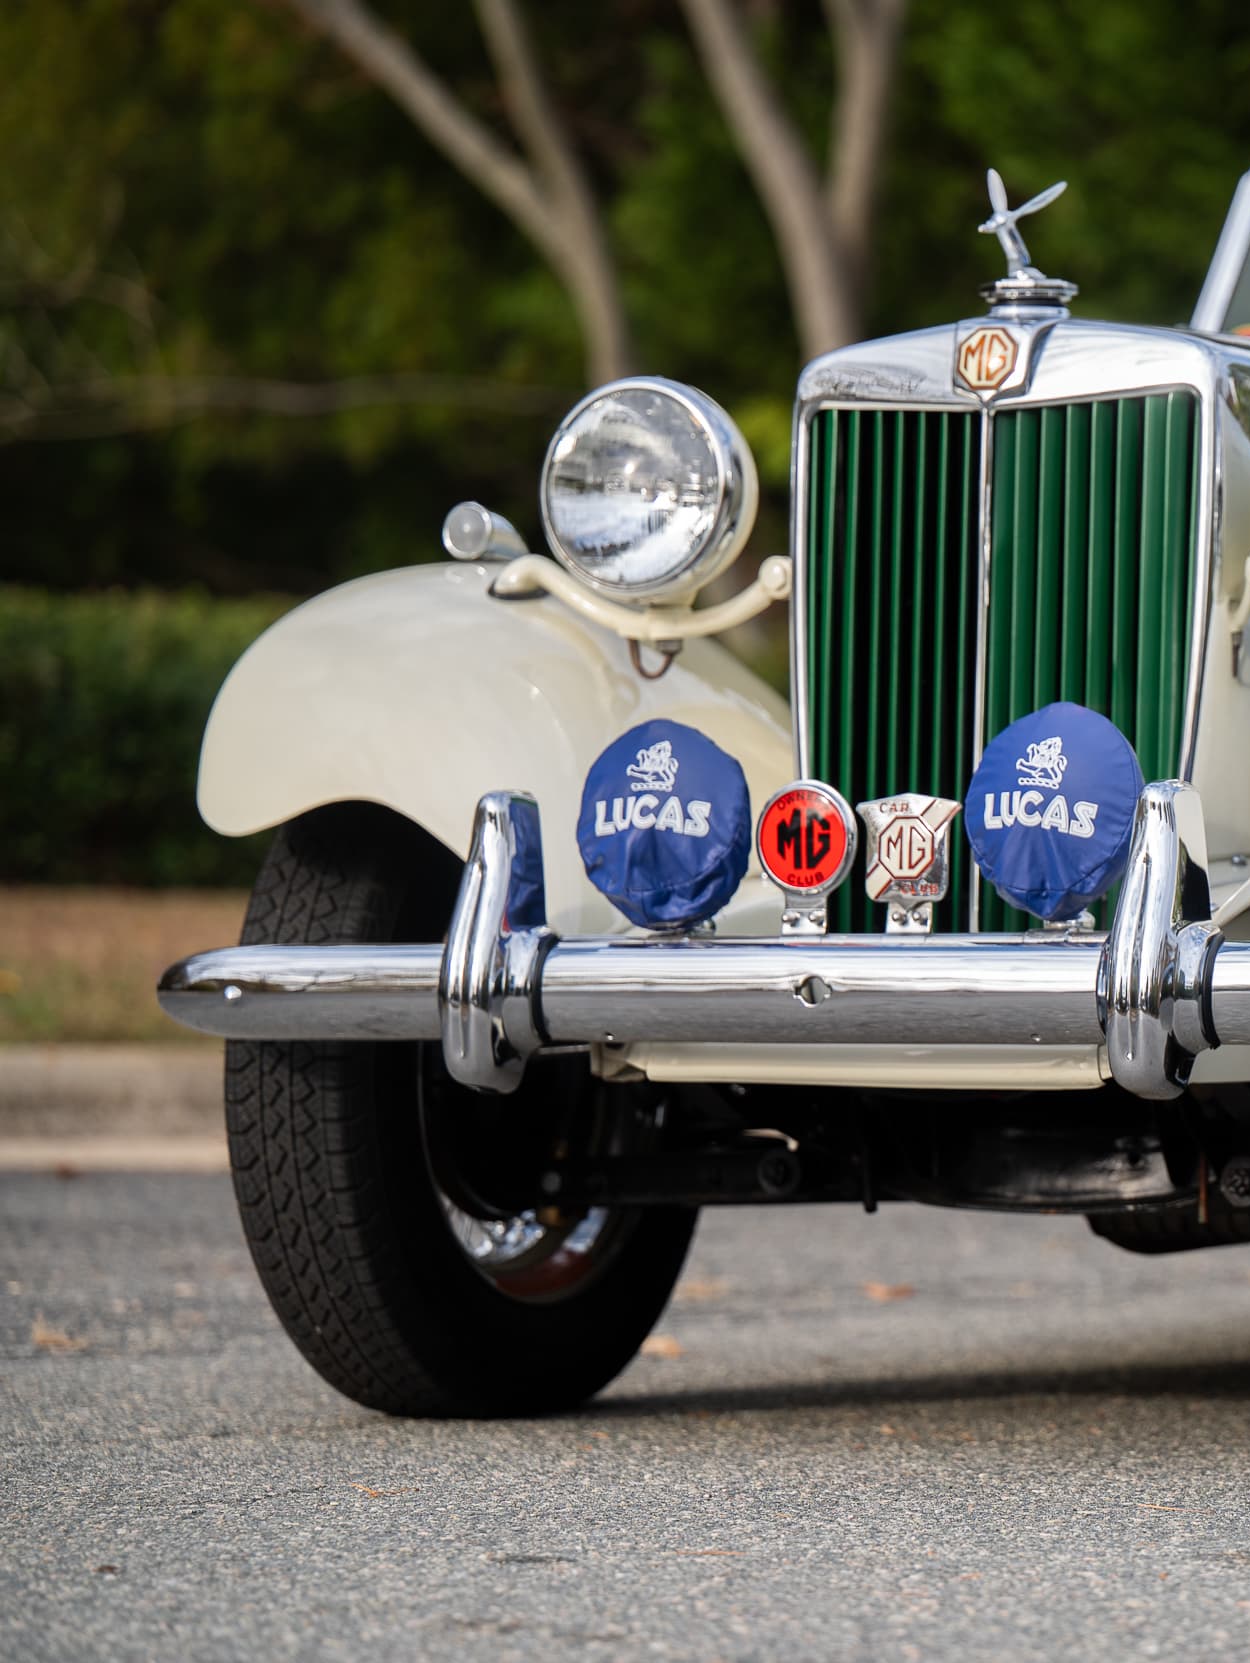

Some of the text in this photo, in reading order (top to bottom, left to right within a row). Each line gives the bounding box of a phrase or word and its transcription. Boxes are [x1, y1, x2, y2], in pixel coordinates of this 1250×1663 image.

[963, 333, 1009, 382] MG
[595, 793, 712, 838] LUCAS
[880, 802, 909, 813] CAR
[983, 790, 1099, 838] LUCAS
[777, 807, 831, 869] MG
[886, 824, 926, 870] MG
[787, 871, 825, 886] CLUB
